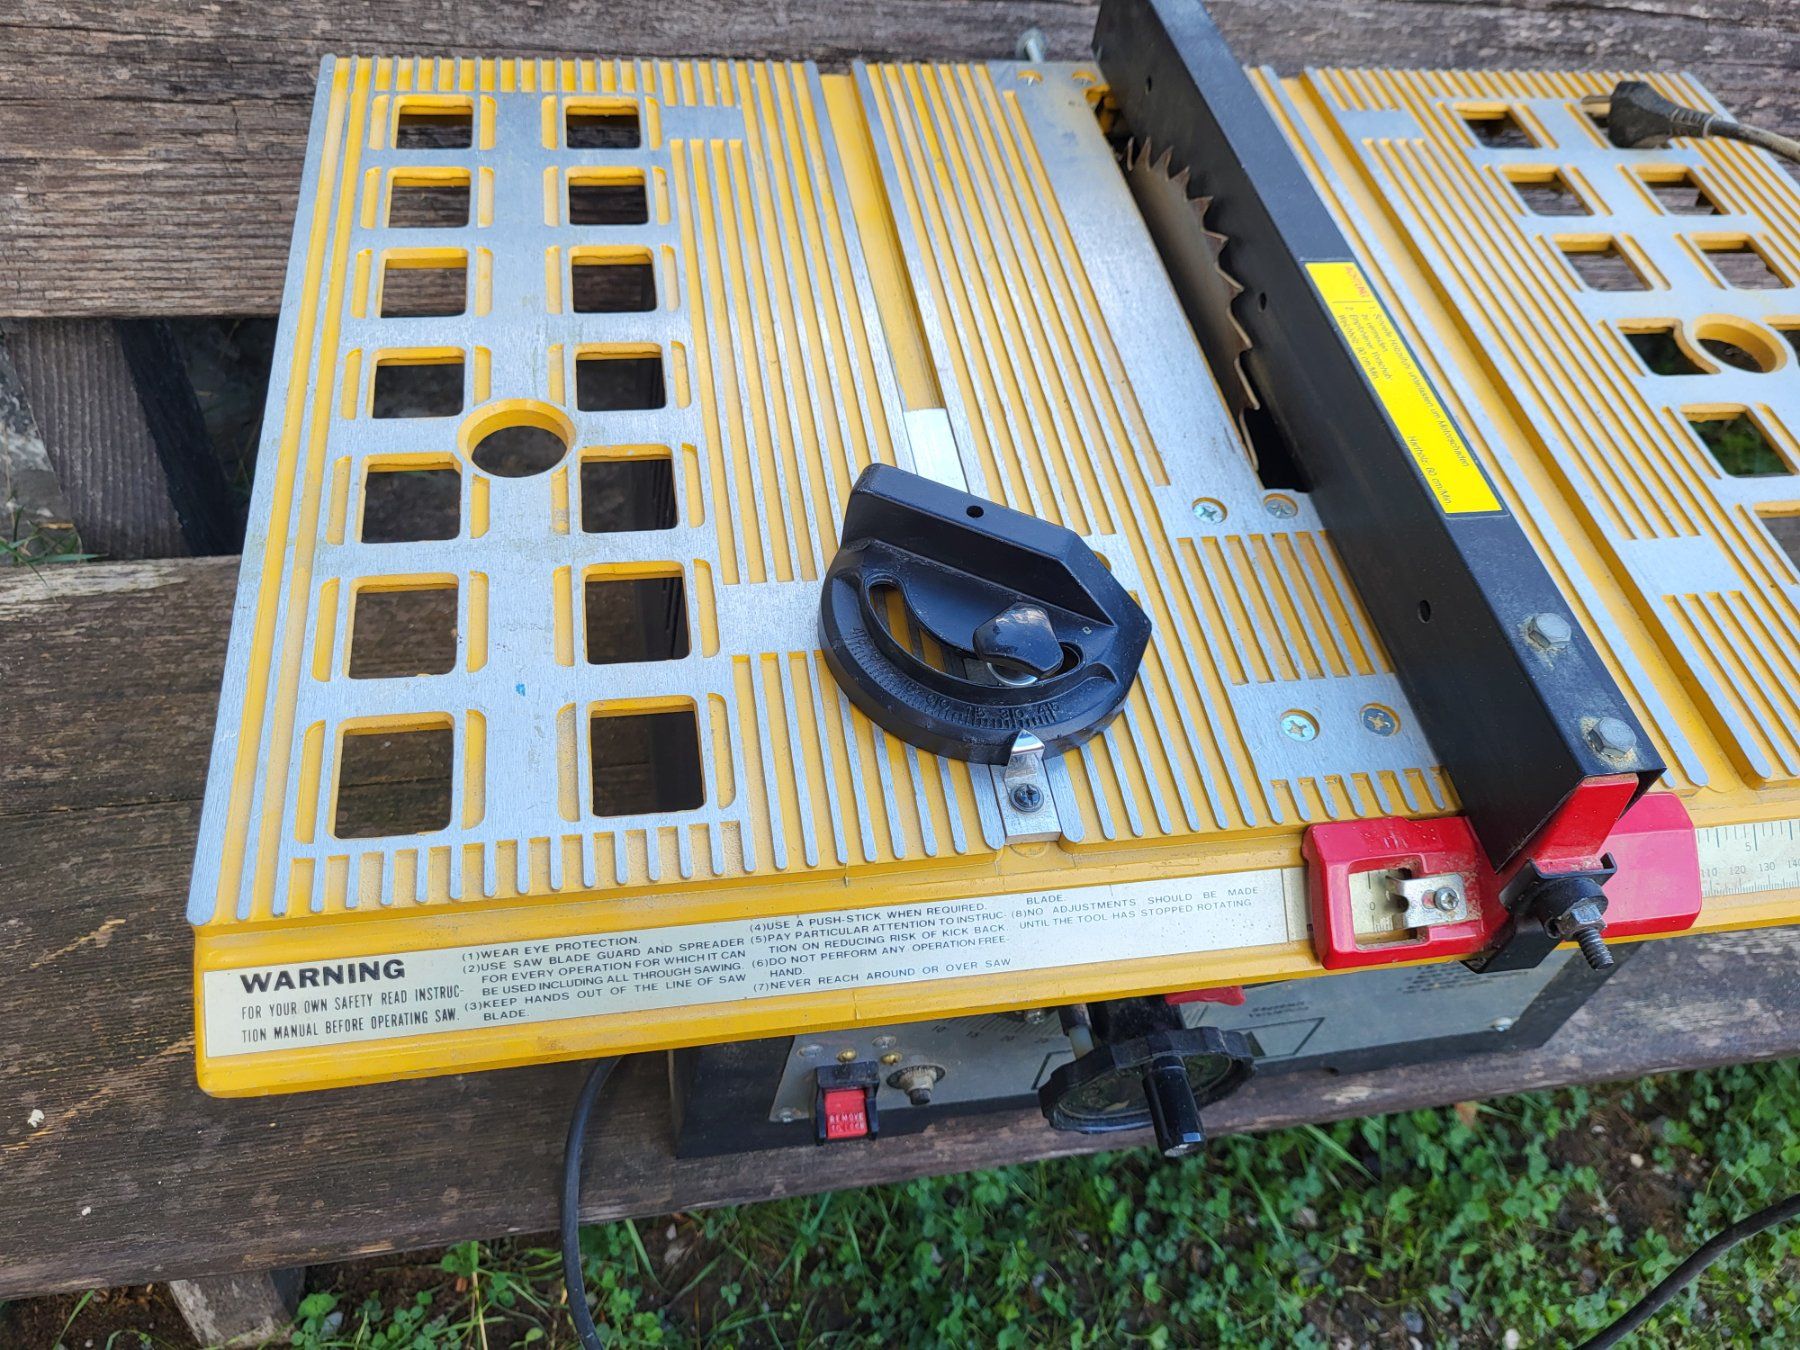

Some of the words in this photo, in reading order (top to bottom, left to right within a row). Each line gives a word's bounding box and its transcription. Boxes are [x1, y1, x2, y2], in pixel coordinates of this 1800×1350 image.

[1744, 842, 1752, 852] 5
[1730, 865, 1746, 876] 120
[1759, 862, 1776, 872] 130
[1019, 918, 1051, 930] UNTIL
[1052, 916, 1074, 926] THE
[1076, 912, 1108, 924] TOOL
[1112, 910, 1136, 920] HAS
[1139, 905, 1193, 918] STOPPED
[1197, 899, 1252, 911] ROTATING
[1052, 899, 1137, 915] ADJUSTMENTS
[1147, 894, 1193, 906] SHOULD
[1203, 891, 1218, 899] BE
[1227, 886, 1259, 898] MADE
[794, 925, 870, 941] PARTICULAR
[872, 919, 936, 933] ATTENTION
[938, 916, 955, 927] TO
[956, 912, 1008, 925] INSTRUC-
[795, 919, 805, 930] A
[809, 913, 882, 928] PUSH-STICK
[886, 908, 923, 920] WHEN
[513, 957, 543, 969] SAW
[548, 953, 592, 966] BLADE
[596, 948, 642, 961] GUARD
[647, 945, 674, 956] AND
[679, 938, 745, 952] SPREADER
[524, 945, 550, 955] EYE
[555, 937, 641, 952] PROTECTION.
[768, 944, 798, 956] TION
[801, 942, 820, 953] ON
[824, 936, 886, 950] REDUCING
[889, 932, 917, 944] RISK
[921, 930, 938, 941] OF
[941, 928, 969, 939] KICK
[790, 954, 817, 966] NOT
[820, 948, 879, 961] PERFORM
[881, 945, 905, 956] ANY
[911, 939, 976, 952] OPERATION
[240, 959, 406, 994] WARNING
[481, 974, 508, 984] FOR
[511, 969, 555, 981] EVERY
[557, 961, 632, 977] OPERATION
[634, 958, 661, 969] FOR
[663, 954, 706, 966] WHICH
[707, 952, 719, 961] IT
[720, 950, 746, 961] CAN
[769, 967, 806, 979] HAND.
[817, 974, 859, 986] REACH
[866, 968, 916, 981] AROUND
[922, 965, 940, 976] OR
[945, 962, 978, 974] OVER
[985, 958, 1012, 969] SAW
[482, 986, 500, 997] BE
[502, 983, 537, 995] USED
[538, 976, 605, 991] INCLUDING
[606, 973, 631, 984] ALL
[632, 967, 692, 981] THROUGH
[524, 992, 570, 1004] HANDS
[576, 989, 603, 999] OUT
[609, 986, 627, 996] OF
[633, 983, 659, 992] THE
[666, 979, 693, 990] LINE
[696, 977, 714, 986] OF
[718, 974, 747, 984] SAW
[242, 1005, 262, 1020] FOR
[269, 1002, 298, 1017] YOUR
[304, 999, 328, 1014] OWN
[334, 994, 373, 1010] SAFETY
[381, 990, 408, 1006] READ
[415, 985, 464, 1002] INSTRUC-
[242, 1028, 267, 1043] TION
[274, 1023, 319, 1039] MANUAL
[325, 1017, 364, 1034] BEFORE
[371, 1011, 429, 1029] OPERATING
[435, 1008, 460, 1023] SAW.
[830, 1112, 864, 1124] REMOVE
